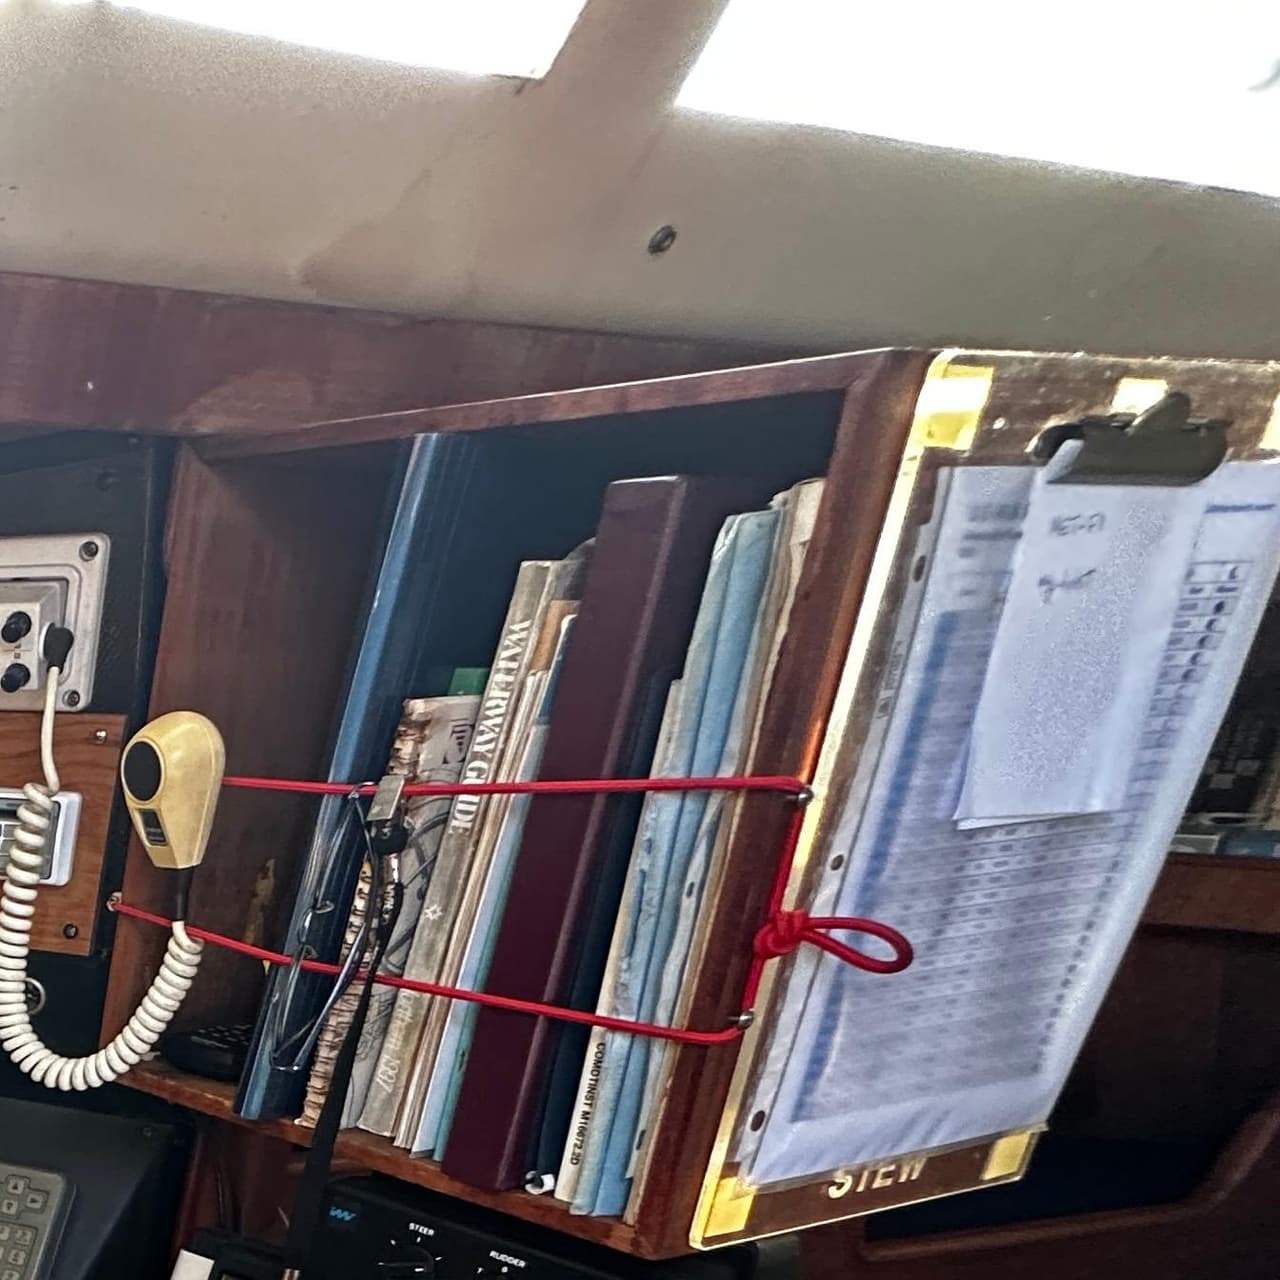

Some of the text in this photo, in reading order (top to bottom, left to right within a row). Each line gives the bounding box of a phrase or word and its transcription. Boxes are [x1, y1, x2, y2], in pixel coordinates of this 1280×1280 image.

[450, 619, 532, 835] WATERWAY GUIDE
[376, 986, 417, 1093] orthern 1997
[583, 1042, 607, 1109] COMDTINST
[408, 1222, 435, 1237] STEER
[489, 1251, 527, 1269] RUDDER
